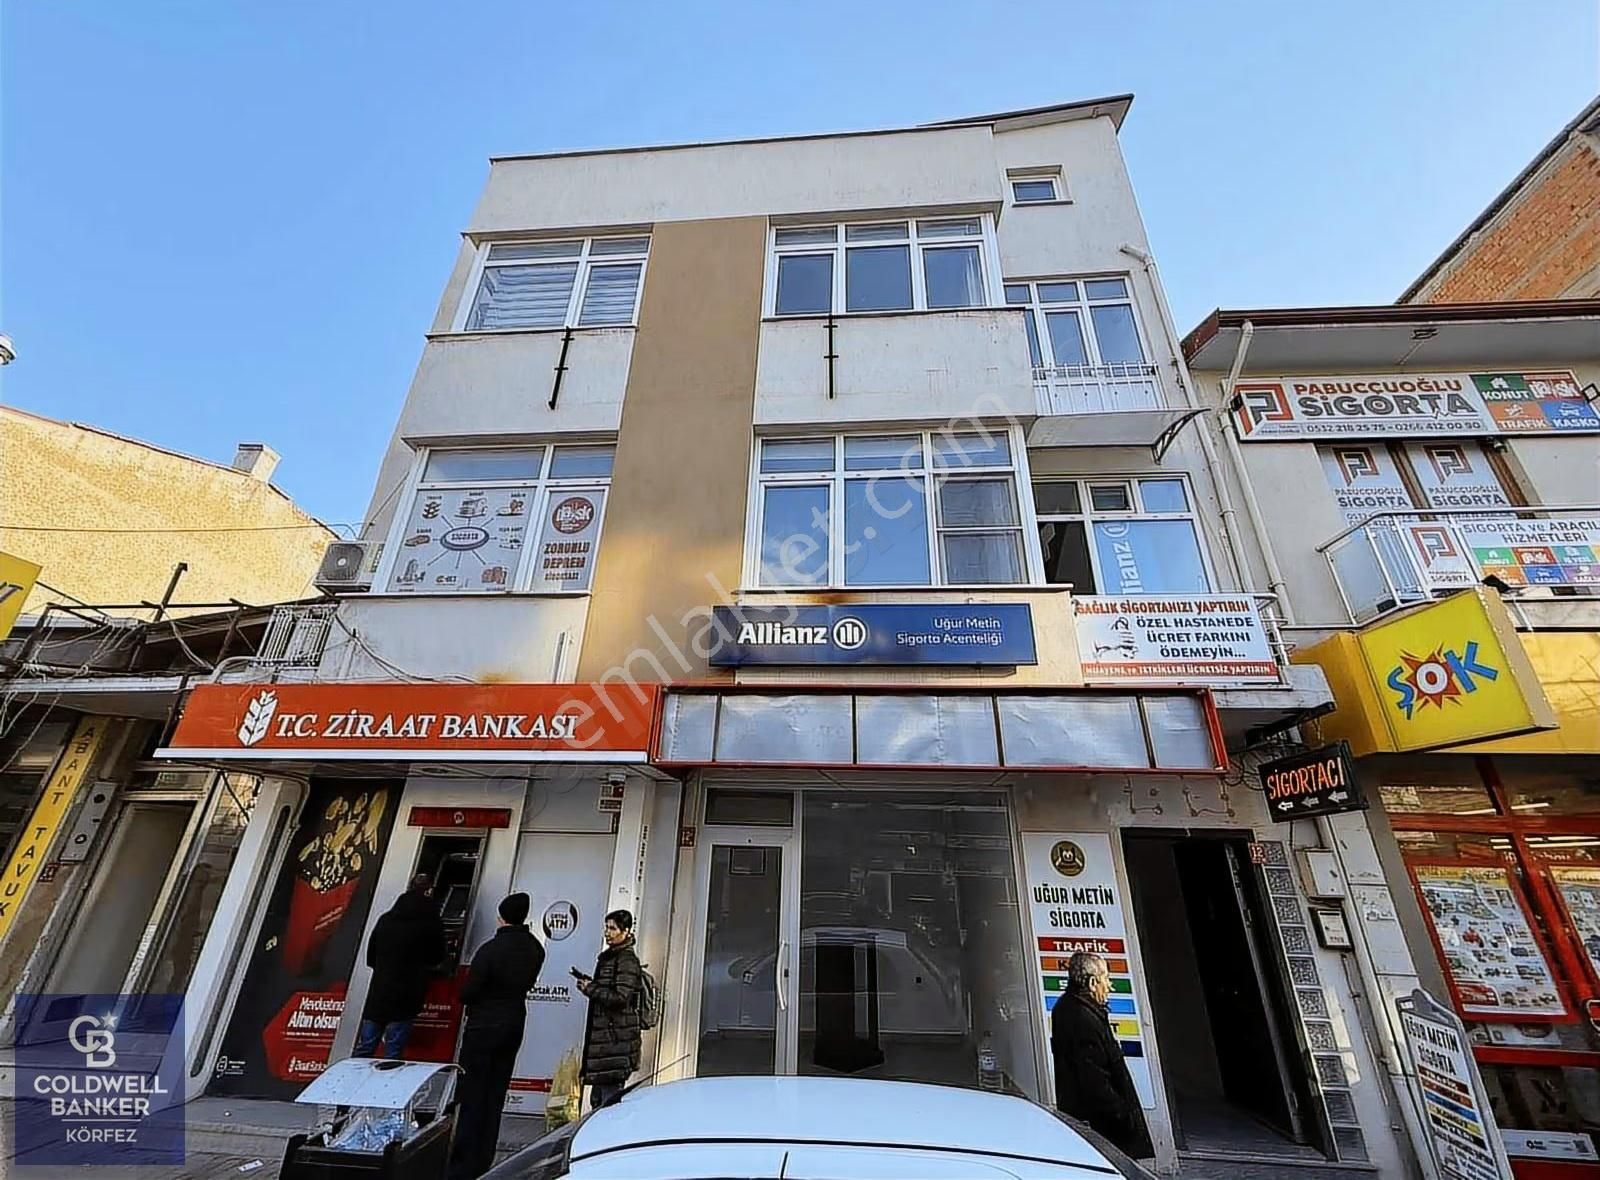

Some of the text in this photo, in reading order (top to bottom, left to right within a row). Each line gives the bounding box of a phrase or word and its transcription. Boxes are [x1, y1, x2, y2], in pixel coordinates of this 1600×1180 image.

[1482, 389, 1530, 401] KONUT
[1552, 417, 1600, 428] KASKO
[1549, 520, 1600, 532] ARACIL
[1076, 600, 1119, 614] SAĞLIK
[933, 617, 1001, 631] Uğur Metin
[1136, 615, 1254, 628] ÖZEL HASTANEDE
[737, 621, 827, 645] Allianz
[896, 631, 1003, 647] Sigorta Acenteliği
[1146, 630, 1251, 643] ÜCRET FARKINI
[1387, 640, 1498, 721] ŞOK
[274, 708, 579, 740] T.C. ZİRAAT BANKASI
[1267, 756, 1346, 800] SİGORTACI
[1033, 883, 1115, 905] UĞUR METİN
[1049, 907, 1106, 929] SİGORTA
[1053, 938, 1110, 952] TRAFİK
